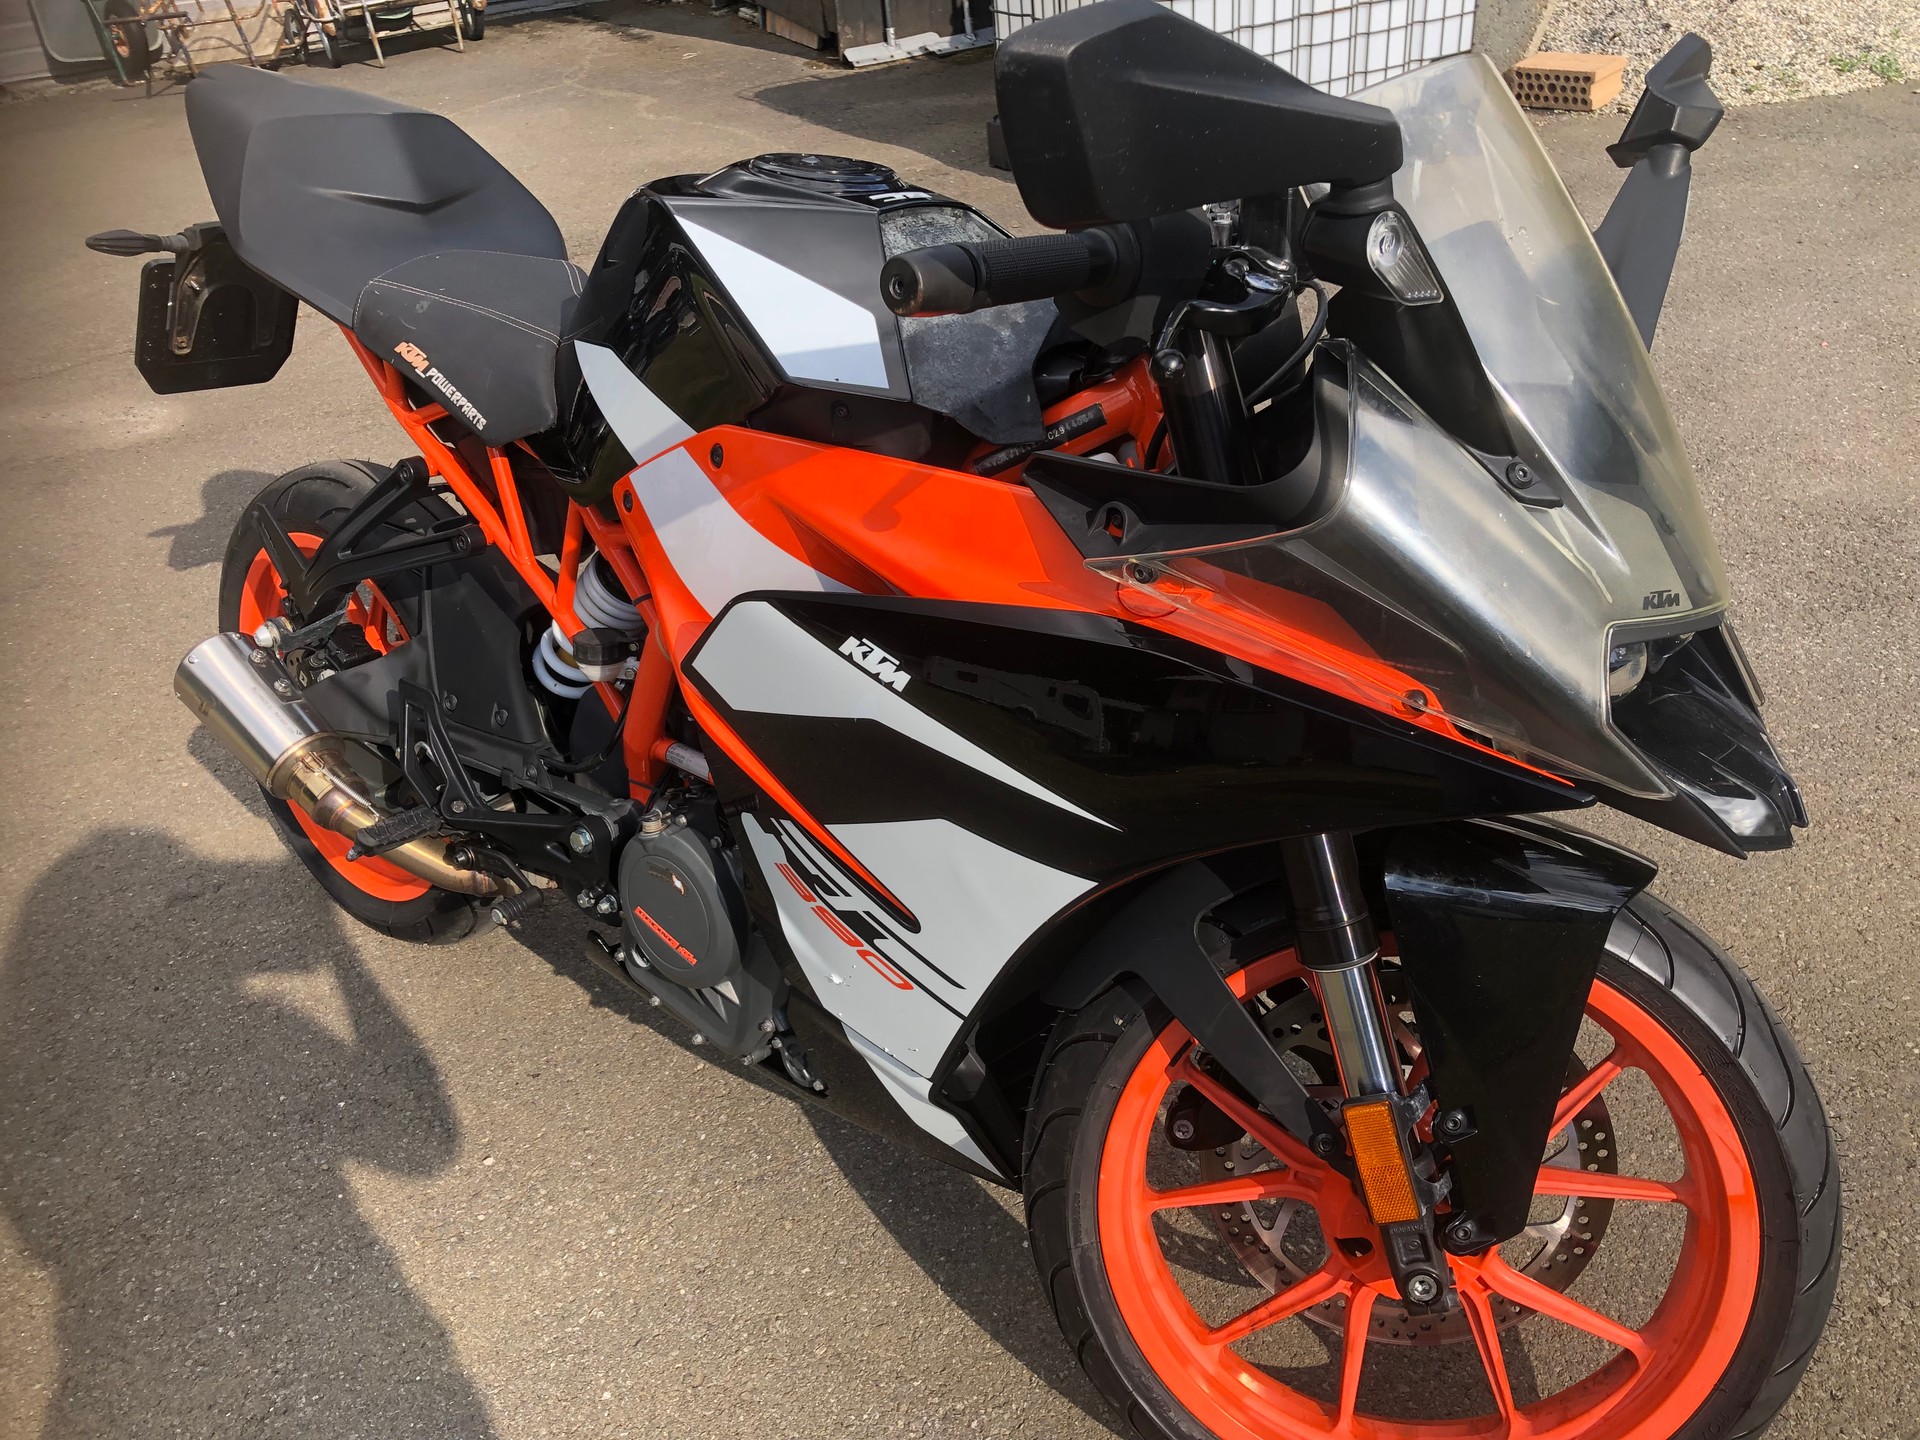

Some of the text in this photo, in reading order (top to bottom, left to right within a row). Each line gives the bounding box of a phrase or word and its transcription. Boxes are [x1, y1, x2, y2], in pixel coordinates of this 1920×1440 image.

[394, 341, 487, 431] KTM POWERPARTS
[1642, 589, 1680, 610] KTM
[838, 635, 912, 693] KTM
[774, 862, 914, 991] 390
